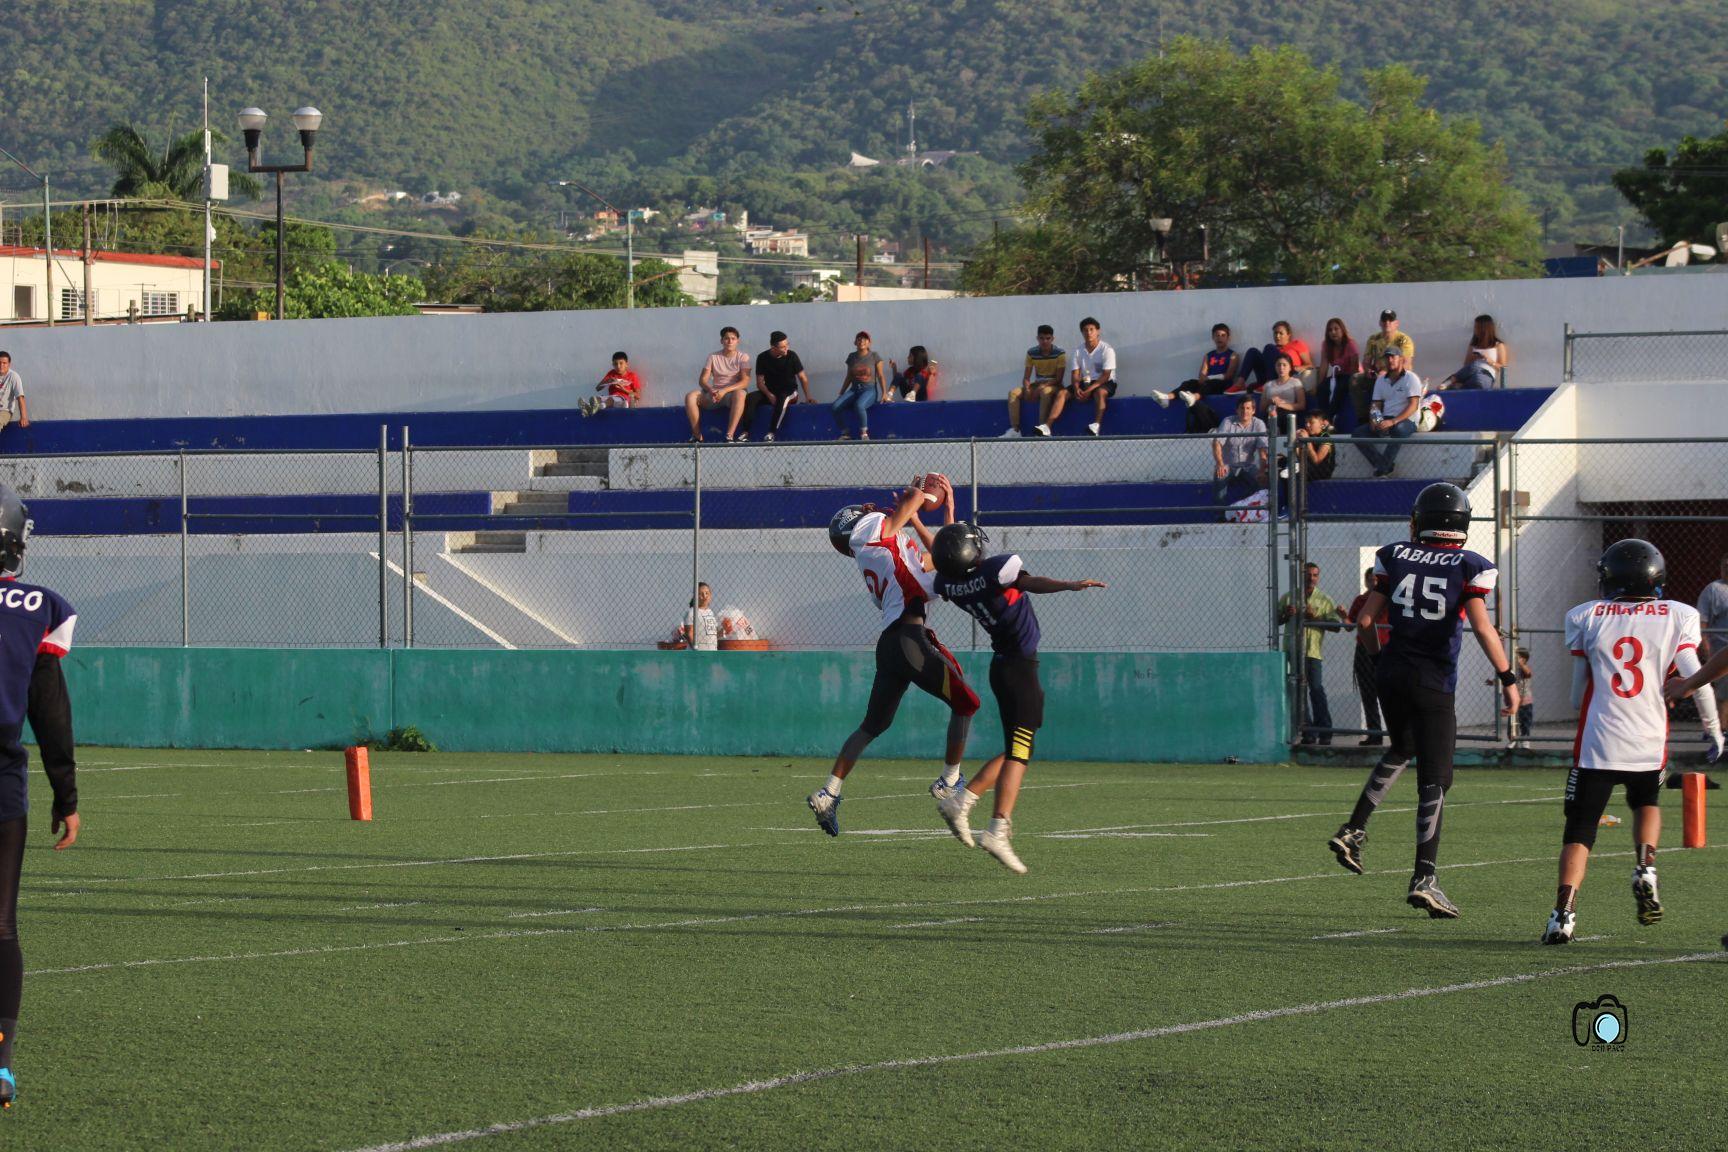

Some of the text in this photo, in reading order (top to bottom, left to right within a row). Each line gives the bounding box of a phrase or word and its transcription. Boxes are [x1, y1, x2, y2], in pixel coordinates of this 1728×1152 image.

[1392, 544, 1464, 566] TABASCO
[944, 576, 987, 596] TABASCO
[1391, 573, 1448, 621] 45
[1594, 603, 1669, 617] CHIAPAS
[1611, 636, 1644, 698] 3
